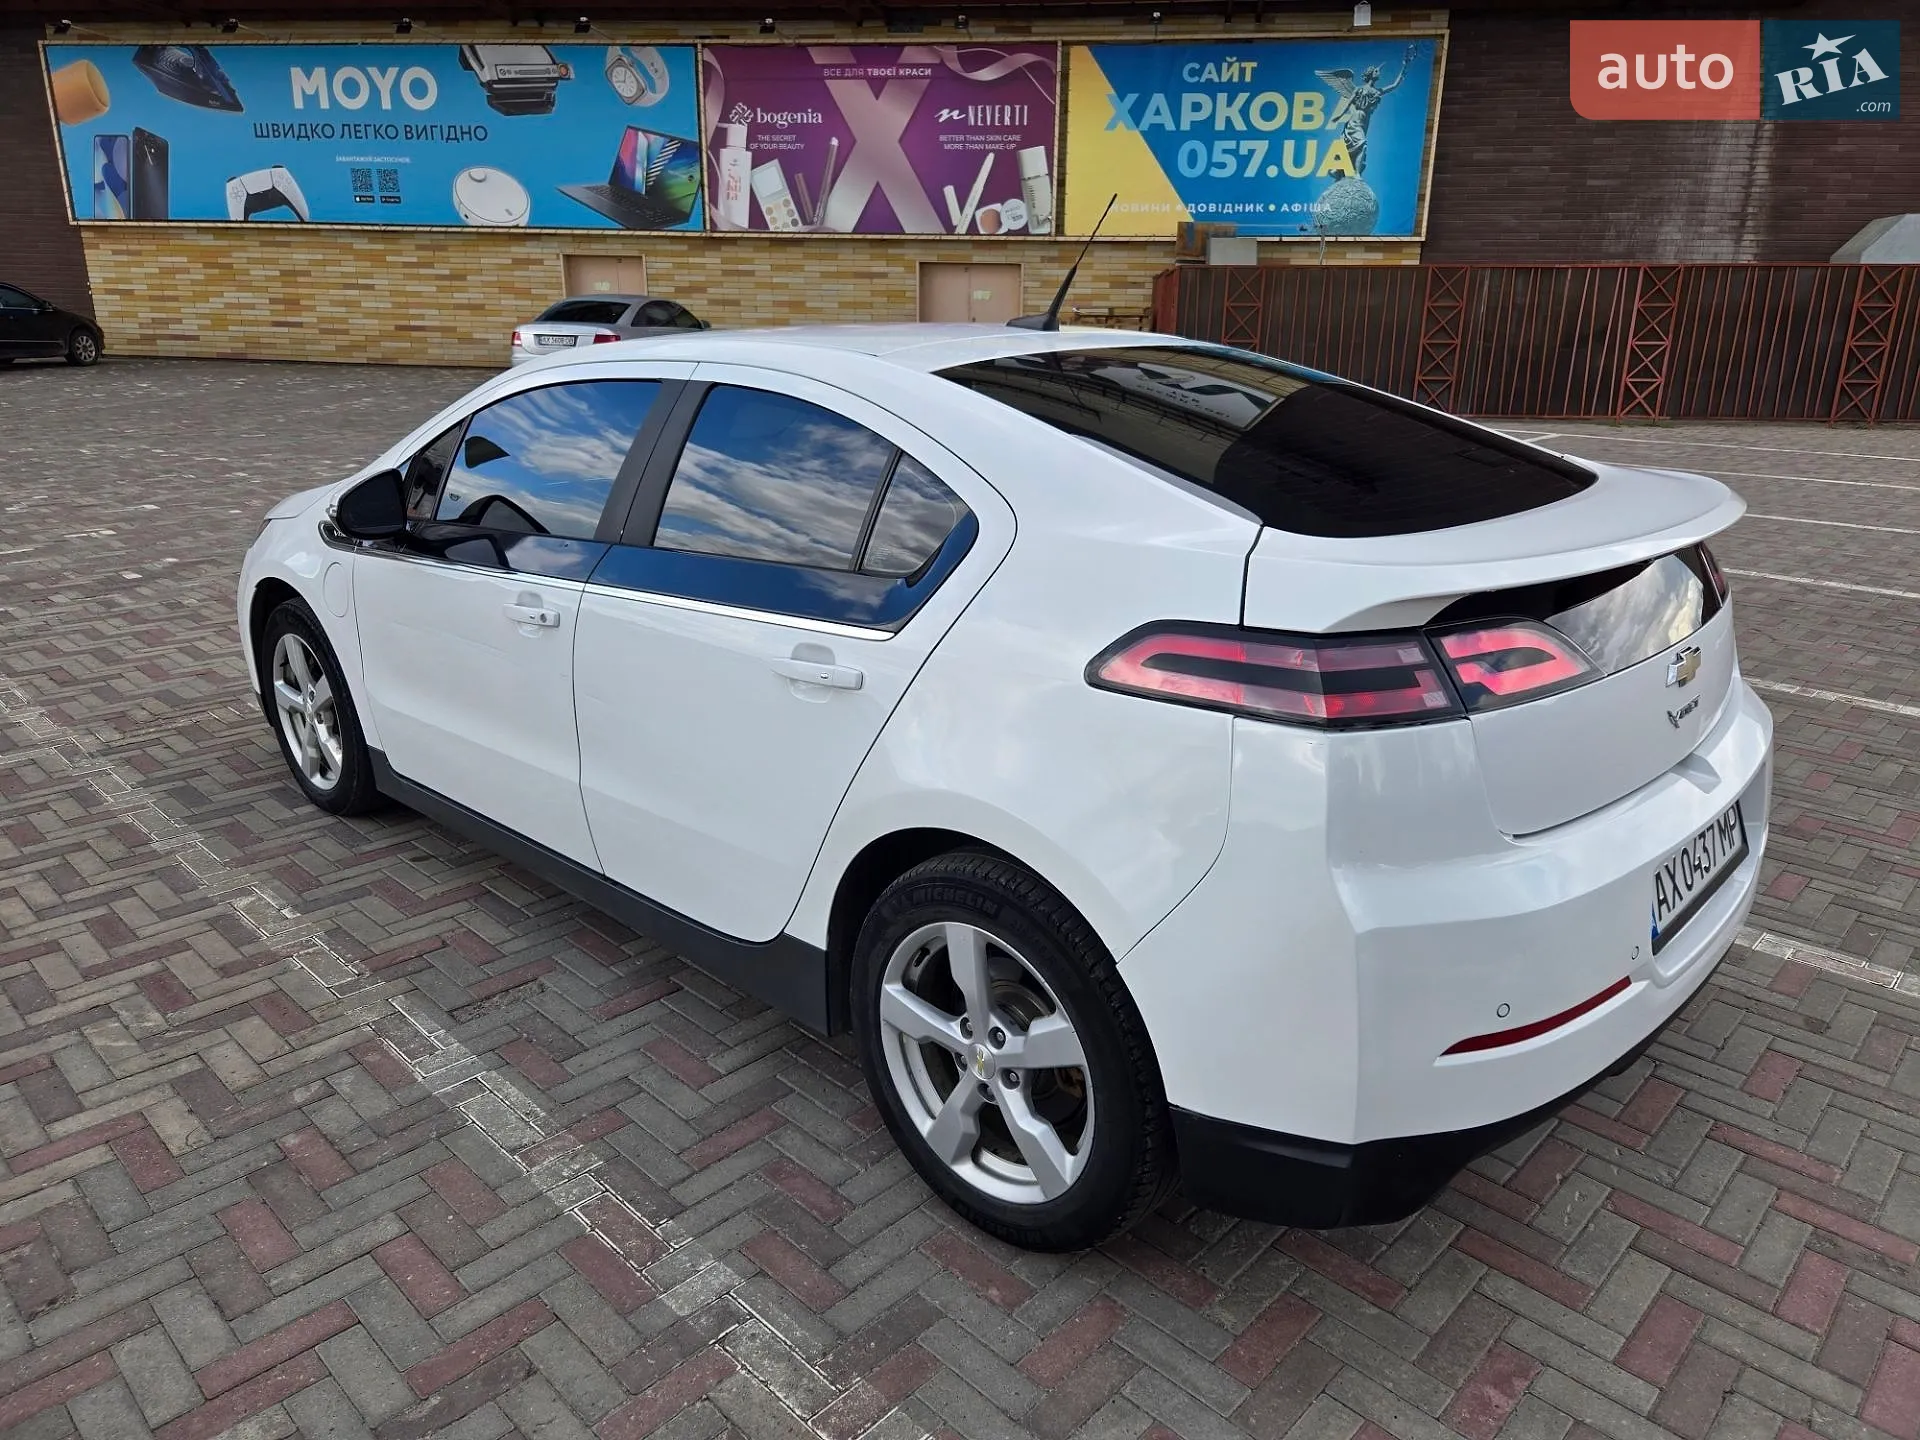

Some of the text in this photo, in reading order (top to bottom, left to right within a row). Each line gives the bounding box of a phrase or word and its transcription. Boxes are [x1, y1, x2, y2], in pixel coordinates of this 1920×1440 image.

[823, 68, 841, 77] ВСЕ
[844, 68, 864, 77] ДЛЯ
[899, 68, 932, 76] КРАСИ
[1182, 56, 1258, 83] САЙТ
[290, 66, 438, 111] MOYO
[756, 107, 823, 129] bogenia
[968, 104, 1028, 126] NEVERTI
[253, 122, 489, 144] ШВИДКО ЛЕГКО ВИГІДНО
[757, 134, 797, 142] THE SECRET
[938, 134, 1022, 142] BETTER THAN SKIN CARE
[1177, 139, 1356, 178] 057.UA
[1187, 203, 1265, 215] ДОВІДНИК
[1281, 202, 1332, 213] АФІША
[1654, 804, 1738, 922] AX 0437 MP
